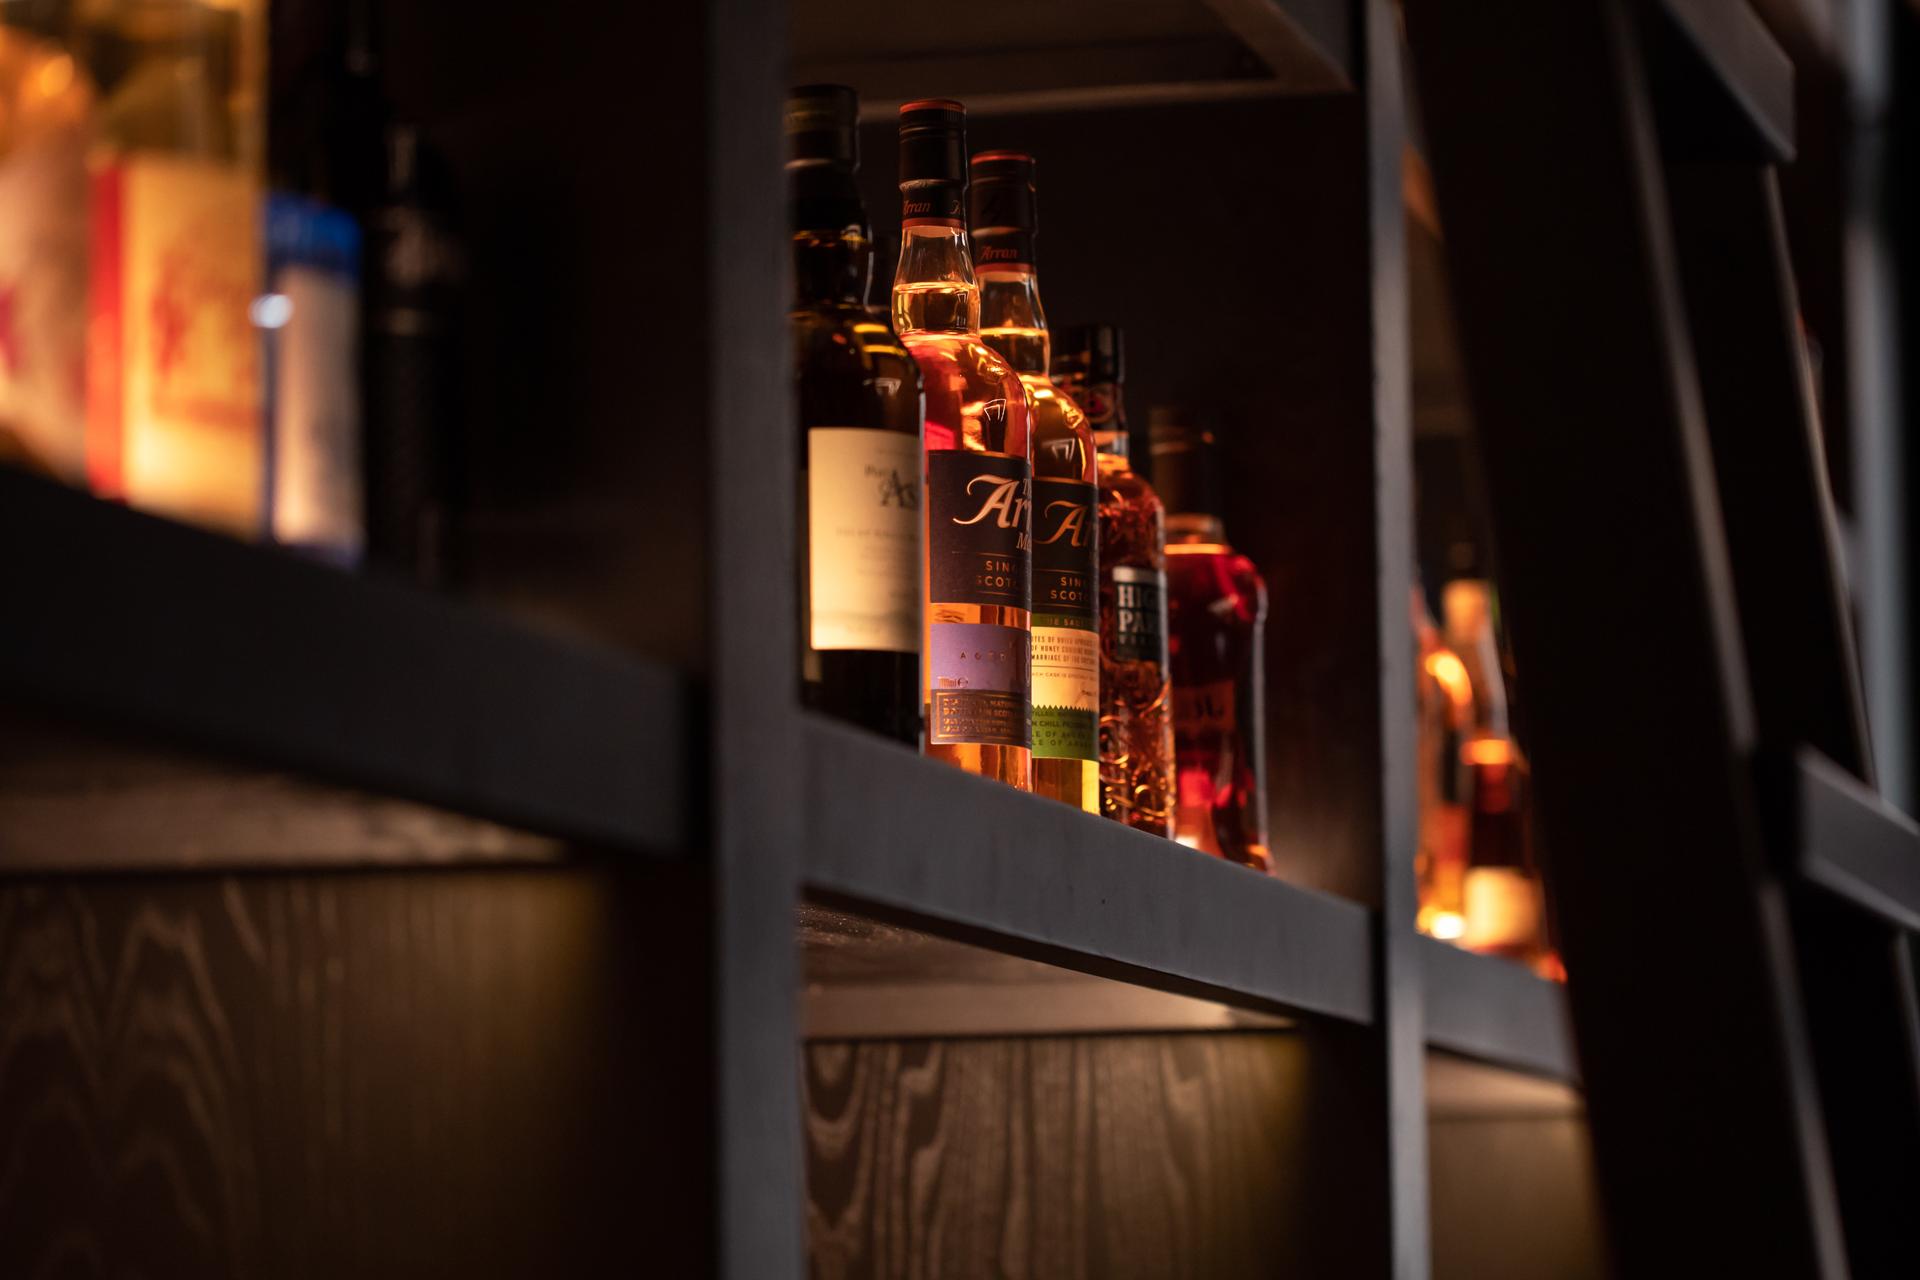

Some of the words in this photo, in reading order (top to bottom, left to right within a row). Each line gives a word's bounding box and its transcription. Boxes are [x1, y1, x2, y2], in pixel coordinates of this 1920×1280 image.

[981, 246, 1018, 261] Arran
[985, 559, 1015, 572] SIN
[977, 575, 1016, 588] SCOT
[1117, 609, 1155, 633] PA
